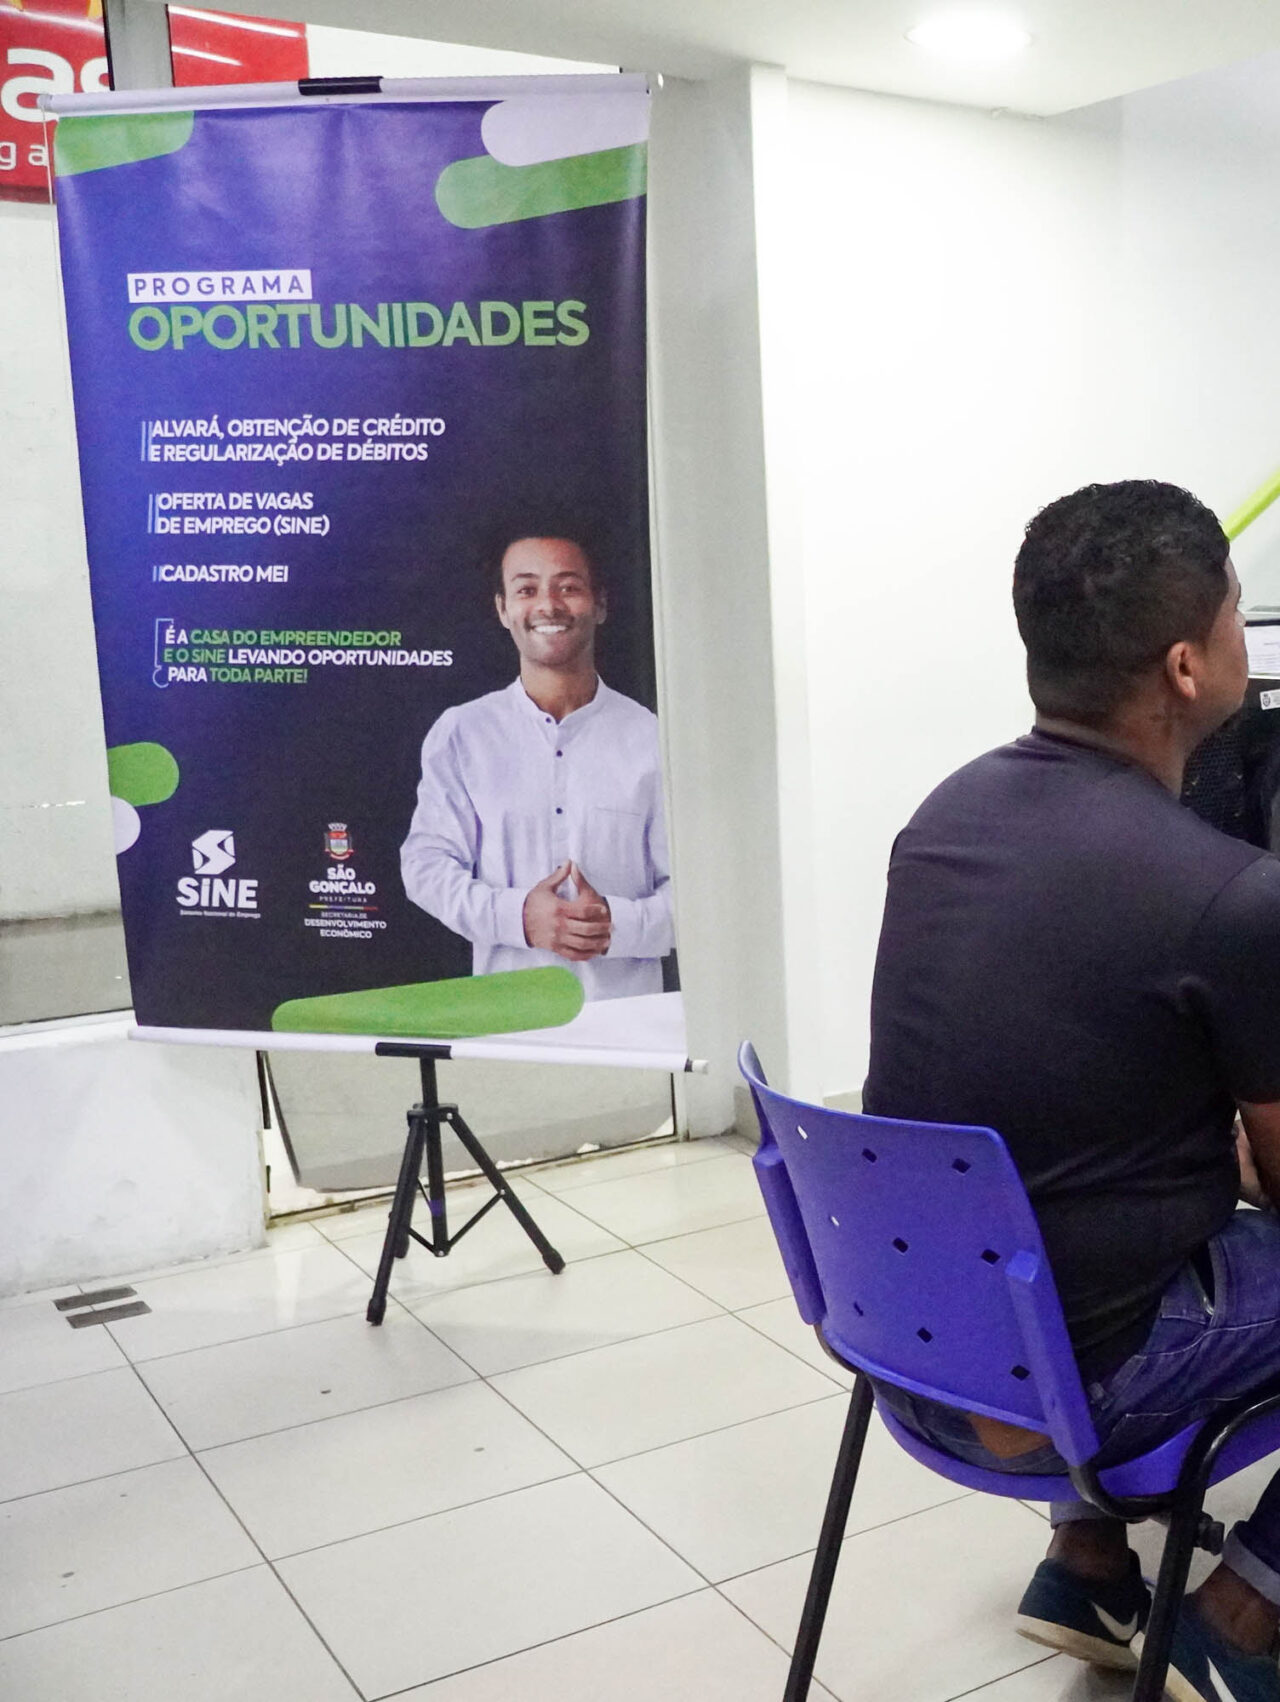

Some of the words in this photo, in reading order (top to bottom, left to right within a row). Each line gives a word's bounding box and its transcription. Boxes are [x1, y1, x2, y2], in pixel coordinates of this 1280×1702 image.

[134, 275, 304, 296] PROGRAMA
[129, 300, 591, 351] OPORTUNIDADES
[152, 414, 224, 440] ALVARÁ,
[227, 414, 329, 442] OBTENÇÃO
[332, 418, 360, 436] DE
[362, 413, 446, 436] CRÉDITO
[151, 444, 161, 462] E
[163, 439, 313, 466] REGULARIZAÇÃO
[316, 443, 343, 461] DE
[346, 439, 428, 461] DÉBITOS
[158, 492, 227, 510] OFERTA
[229, 492, 253, 510] DE
[255, 492, 314, 510] VAGAS
[157, 517, 181, 534] DE
[183, 516, 271, 534] EMPREGO
[273, 514, 330, 536] (SINE)
[160, 565, 253, 582] CADASTRO
[256, 565, 289, 582] MEI
[165, 624, 176, 644] É
[176, 629, 189, 645] A
[190, 629, 230, 645] CASA
[232, 629, 257, 645] DO
[260, 630, 401, 647] EMPREENDEDOR
[163, 649, 173, 663] E
[175, 649, 189, 663] O
[192, 649, 226, 664] SINE
[228, 649, 305, 665] LEVANDO
[308, 650, 453, 666] OPORTUNIDADES
[167, 666, 208, 682] PARA
[210, 667, 251, 683] TODA
[254, 668, 308, 683] PARTE!
[327, 863, 356, 880] SÃO
[309, 880, 376, 895] GONÇALO
[304, 918, 387, 929] DESENVOLVIMENTO
[319, 928, 373, 939] ECONÔMICO
